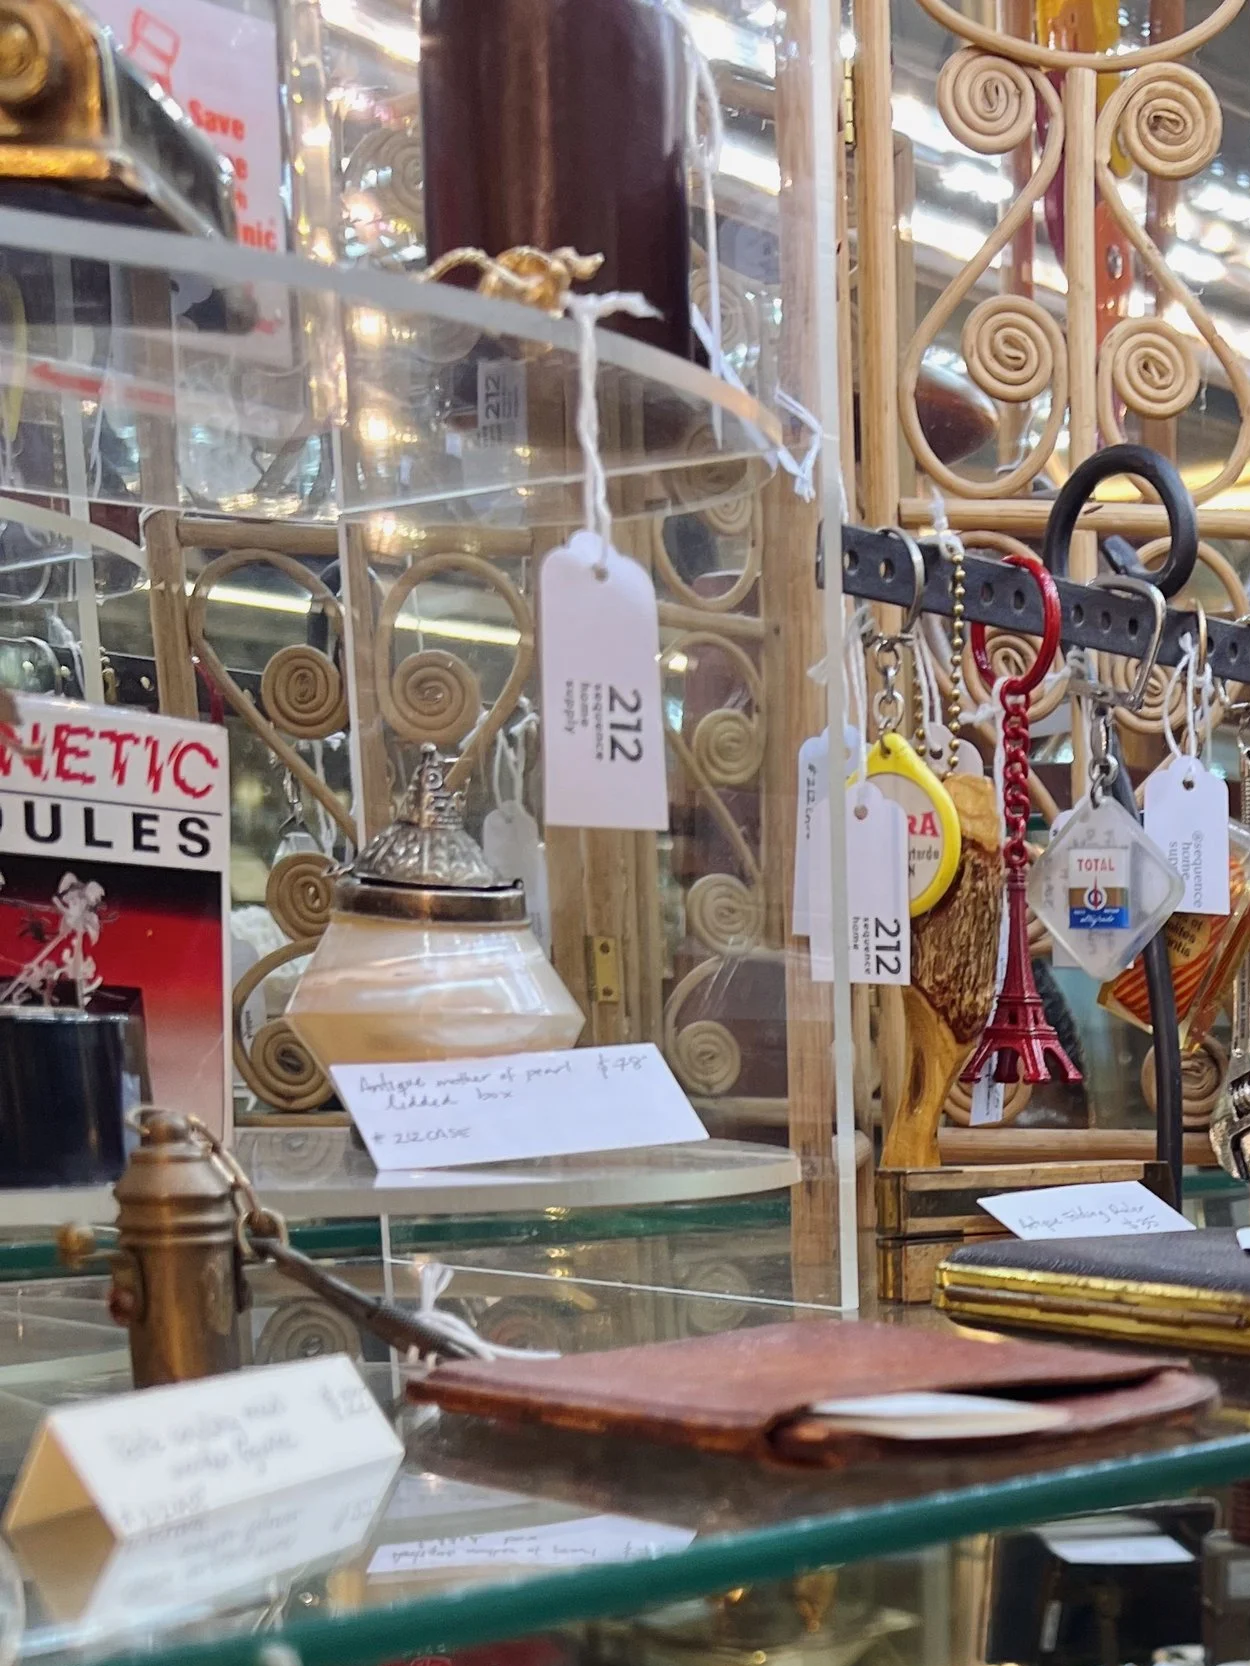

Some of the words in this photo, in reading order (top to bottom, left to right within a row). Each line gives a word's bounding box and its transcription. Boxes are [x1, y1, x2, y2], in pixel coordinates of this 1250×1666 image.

[563, 678, 574, 736] supply
[579, 681, 590, 727] home
[594, 683, 603, 762] sequence
[607, 684, 644, 764] 212
[1077, 858, 1116, 872] TOTAL
[1181, 842, 1193, 881] home
[852, 916, 860, 951] home
[863, 917, 872, 976] sequence
[874, 917, 901, 976] 212
[498, 1066, 515, 1084] of
